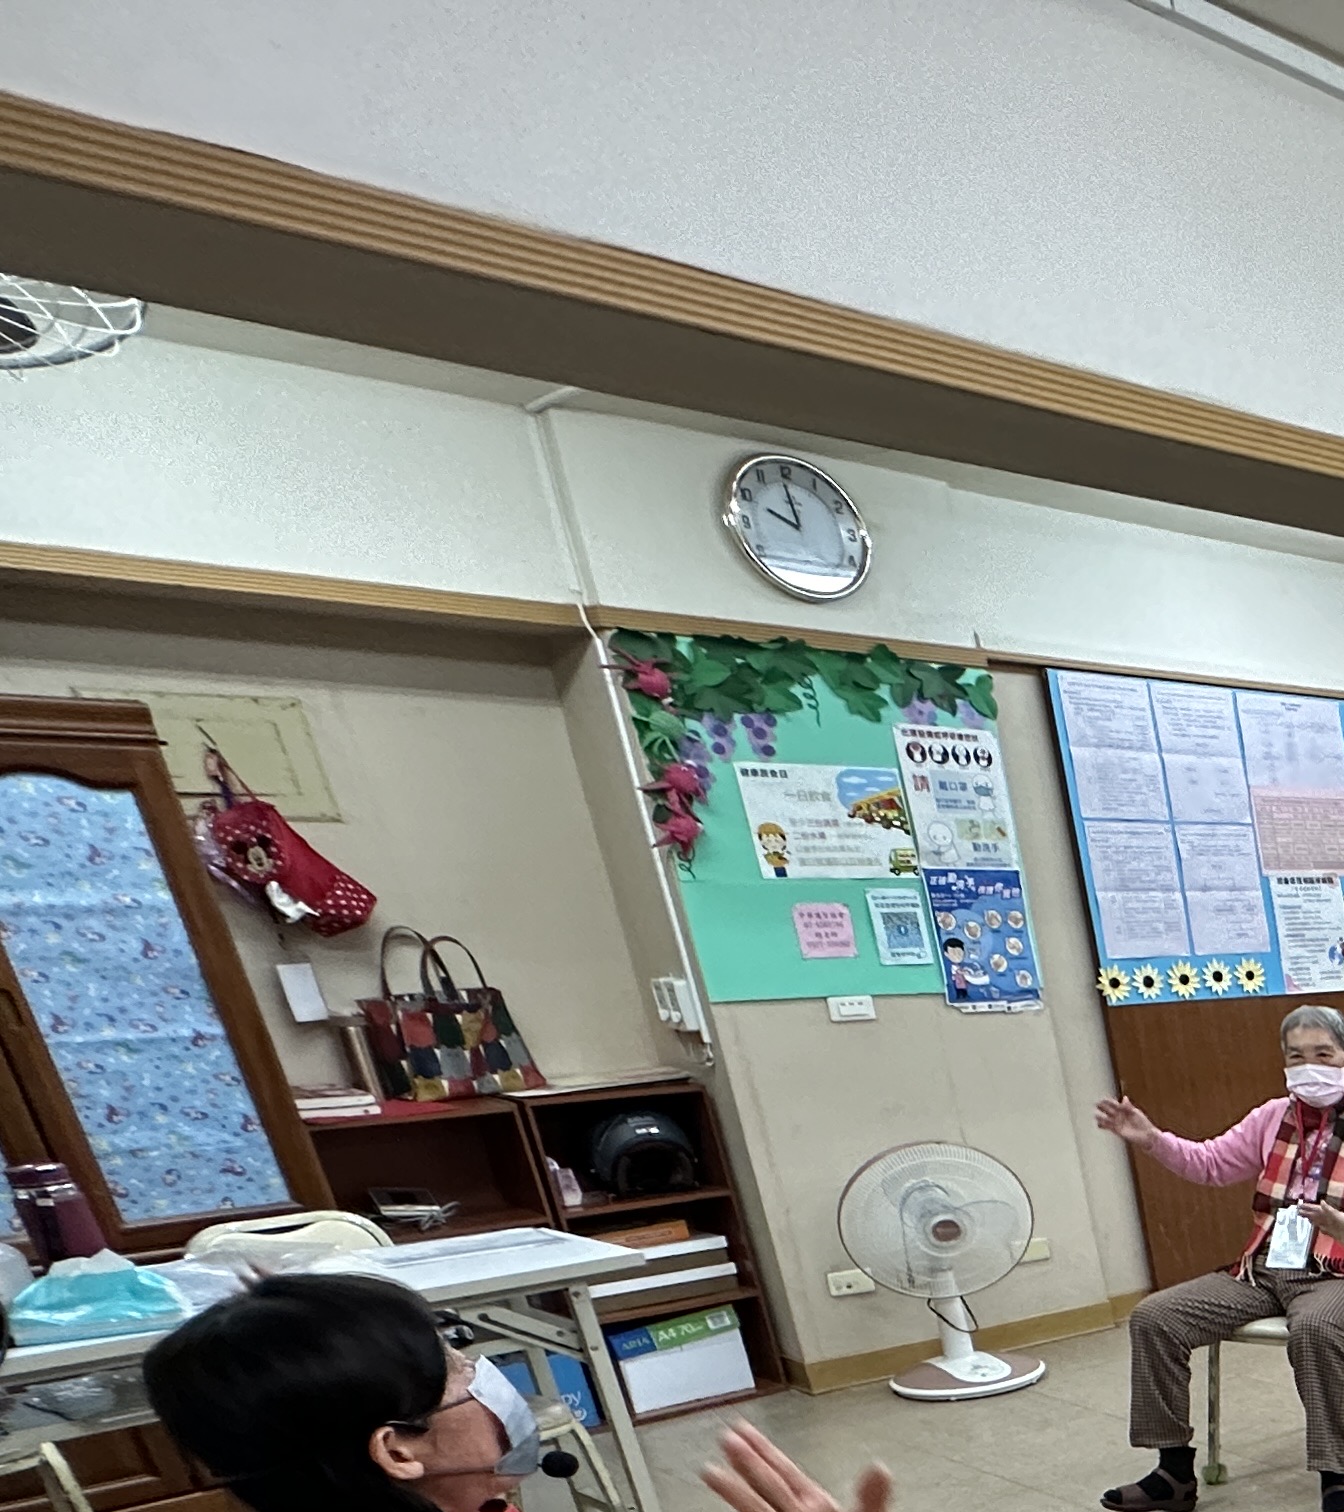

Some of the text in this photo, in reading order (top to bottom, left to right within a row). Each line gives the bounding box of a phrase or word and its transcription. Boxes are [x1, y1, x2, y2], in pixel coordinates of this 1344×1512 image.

[755, 468, 766, 485] 11
[779, 465, 792, 481] 12
[833, 500, 845, 515] 2
[741, 514, 752, 530] 9
[846, 528, 858, 543] 3
[657, 1327, 677, 1342] A4
